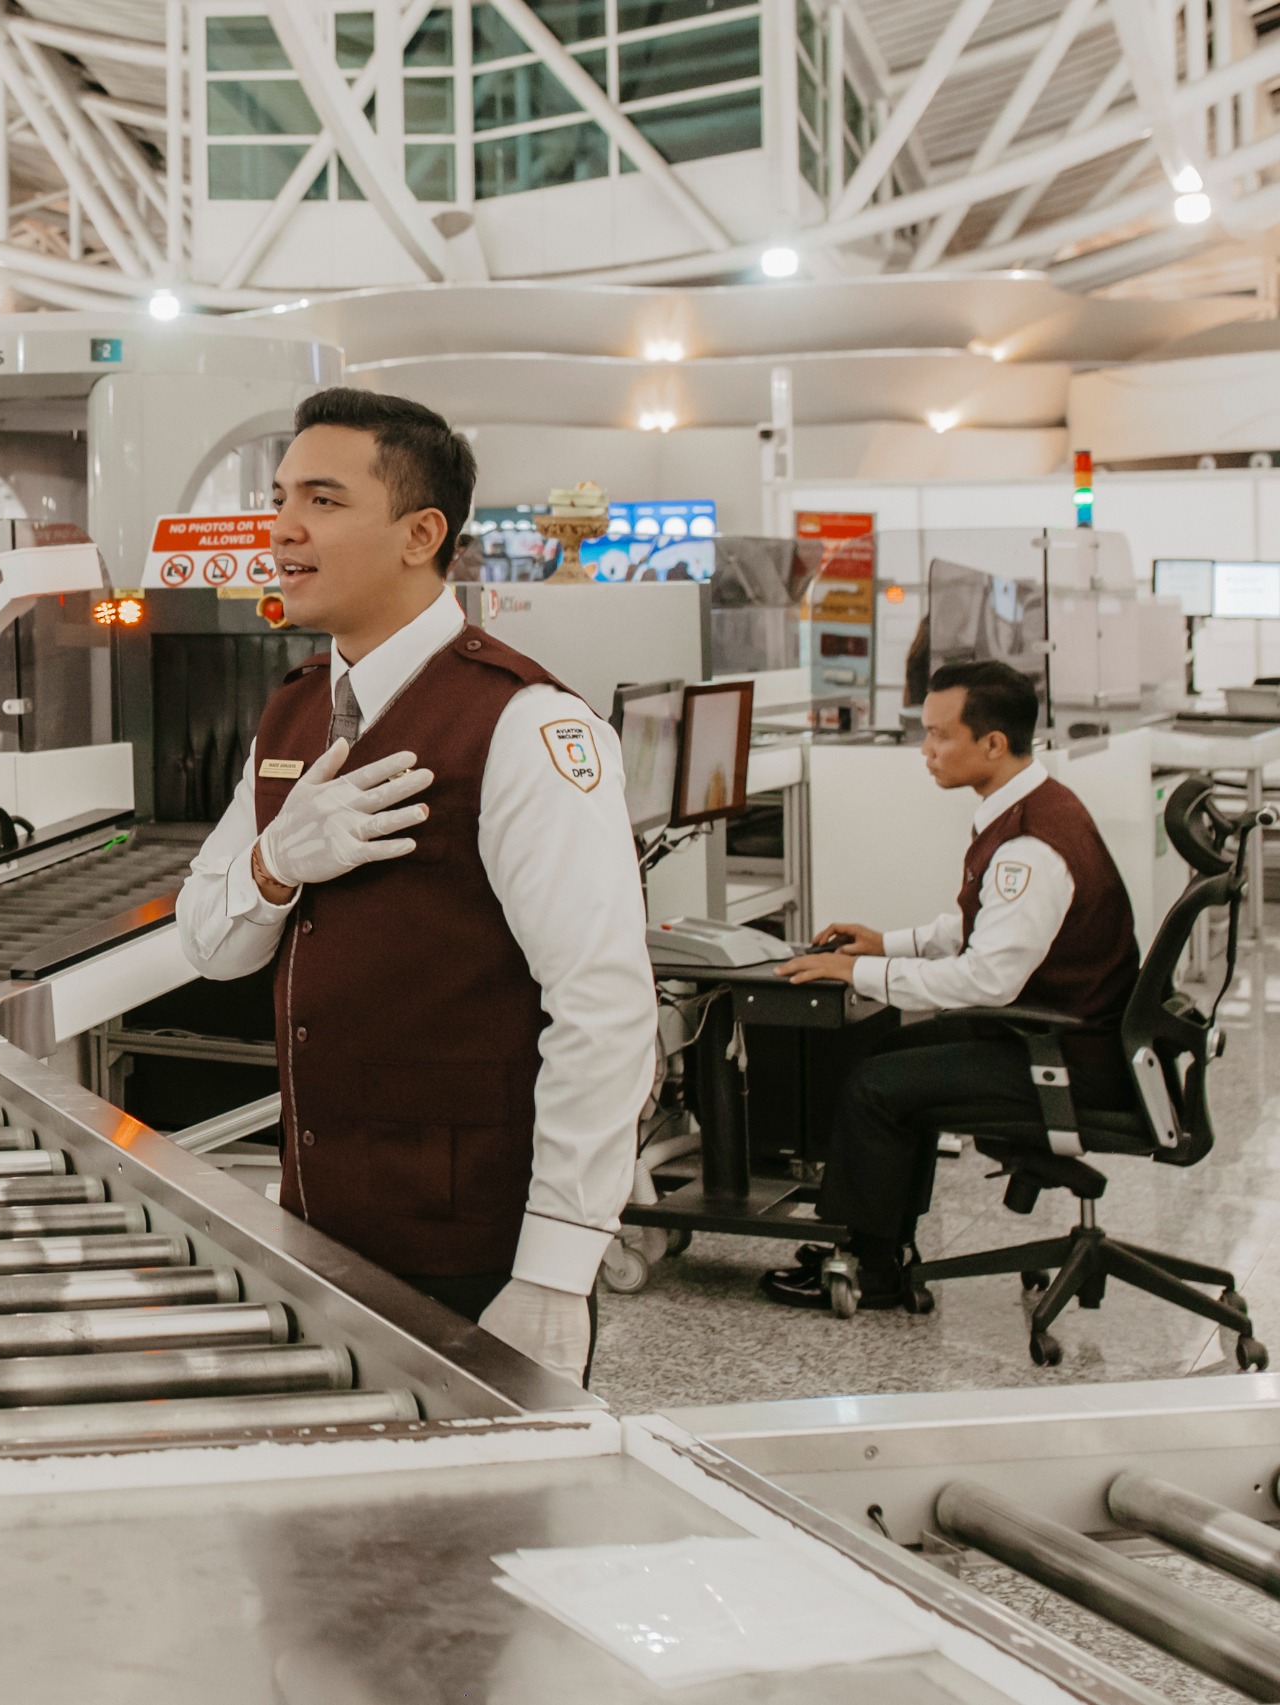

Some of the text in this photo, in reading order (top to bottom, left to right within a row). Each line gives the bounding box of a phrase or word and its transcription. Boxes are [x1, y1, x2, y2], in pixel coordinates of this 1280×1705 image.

[169, 520, 275, 534] NO PHOTOS OR VID
[198, 534, 255, 546] ALLOWED
[572, 768, 594, 777] DPS
